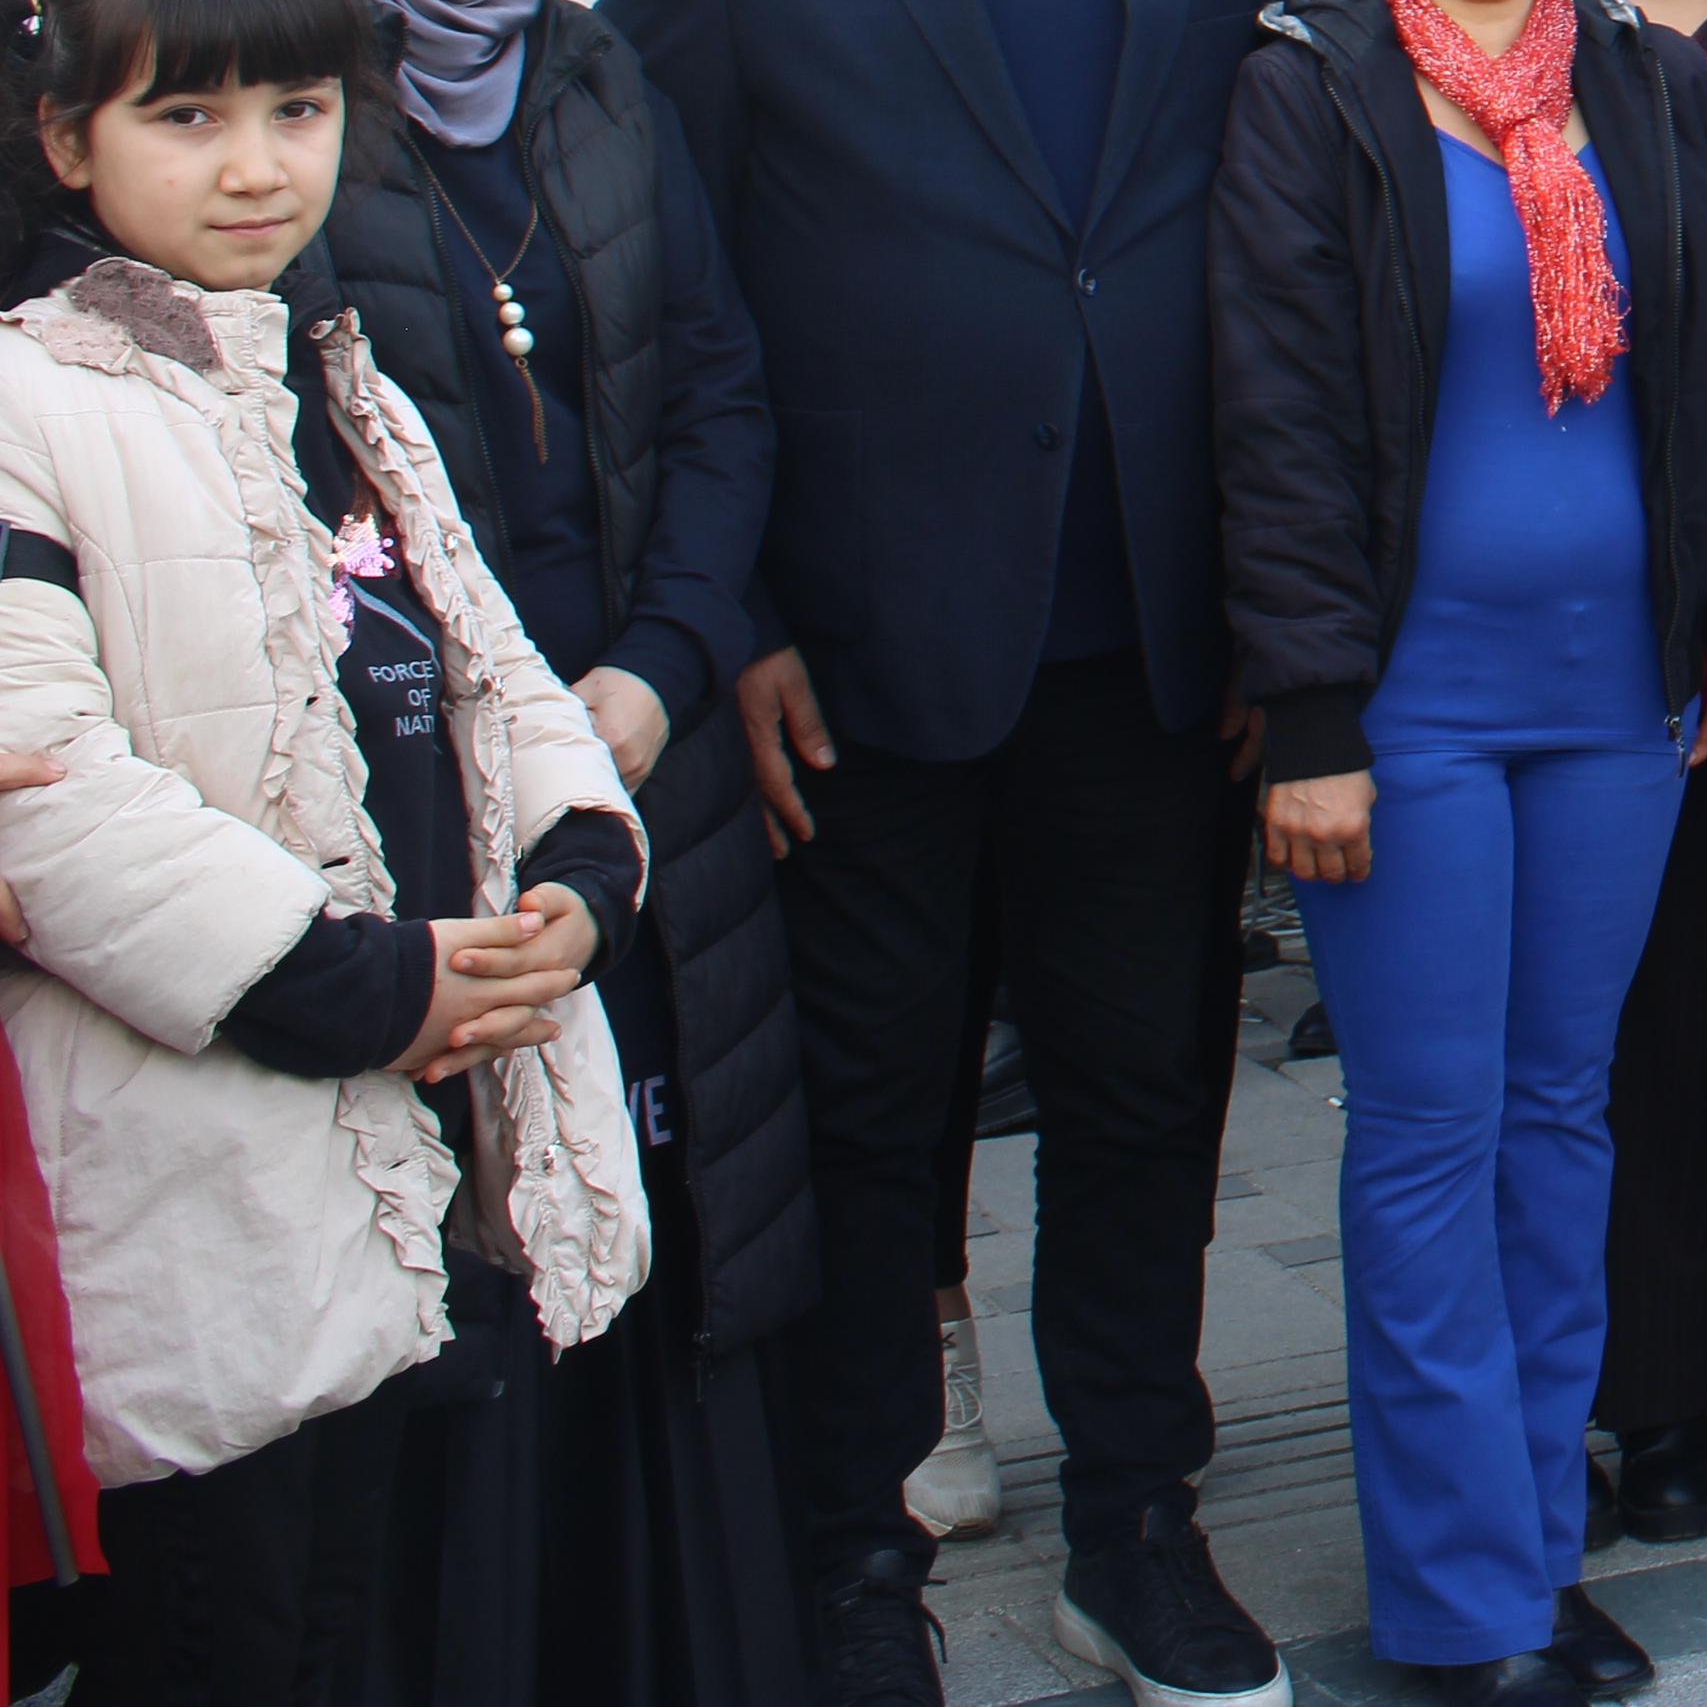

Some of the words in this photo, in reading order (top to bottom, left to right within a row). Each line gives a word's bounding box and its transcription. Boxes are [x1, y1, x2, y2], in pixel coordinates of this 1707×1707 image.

[368, 660, 435, 683] FORCE
[407, 687, 432, 708] OF
[395, 714, 435, 738] NAT
